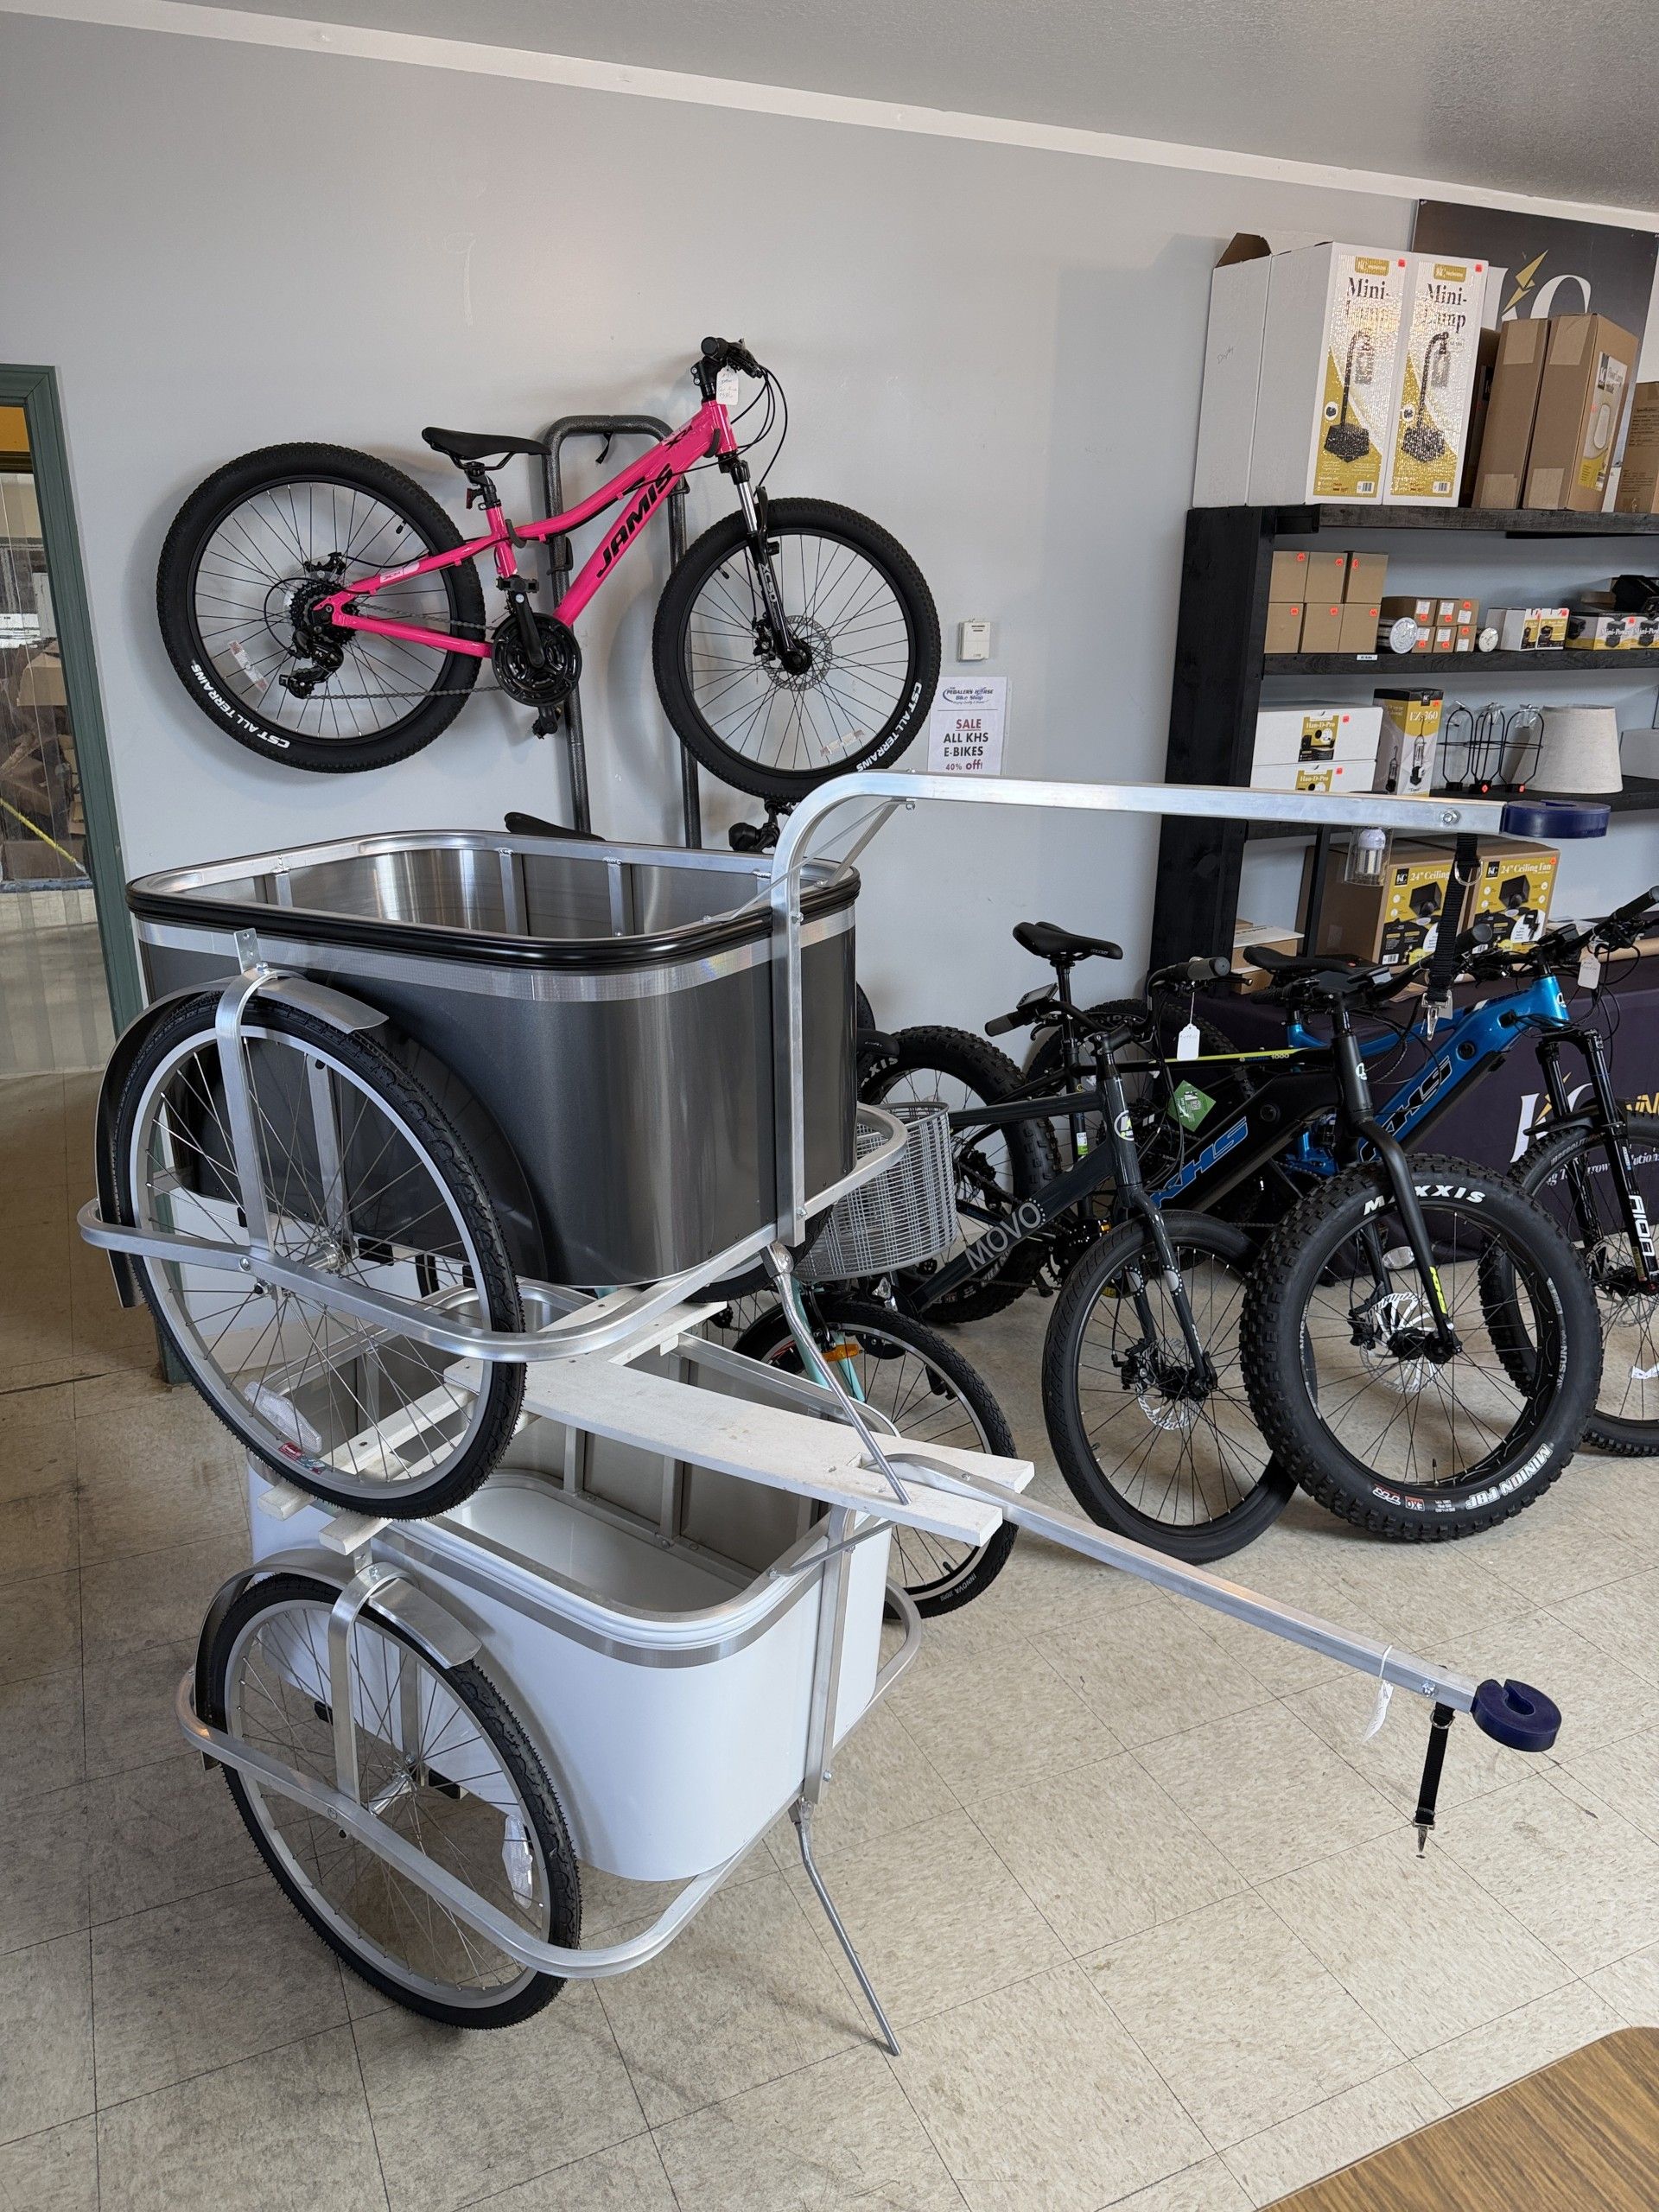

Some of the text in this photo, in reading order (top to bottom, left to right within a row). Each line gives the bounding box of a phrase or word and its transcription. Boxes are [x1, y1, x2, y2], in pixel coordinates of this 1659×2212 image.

[1346, 276, 1390, 301] Mini-
[1425, 283, 1467, 306] Mini-
[596, 462, 673, 579] JAMIS
[190, 664, 291, 749] CST ALL TERRAINS
[855, 681, 923, 772] CST ALL TERRAINS
[956, 718, 982, 729] SALE
[944, 732, 988, 743] ALL KHS
[944, 747, 983, 757] E-BIKES
[965, 759, 982, 770] off!
[1424, 869, 1451, 881] Ceiling
[1513, 862, 1538, 874] Ceiling
[1538, 861, 1552, 872] Fan
[1363, 1185, 1486, 1217] MXXIS
[965, 1202, 1041, 1271] MOVO
[1498, 1442, 1554, 1497] MINION
[1406, 1499, 1425, 1511] EXO
[954, 1572, 977, 1594] INNOVA
